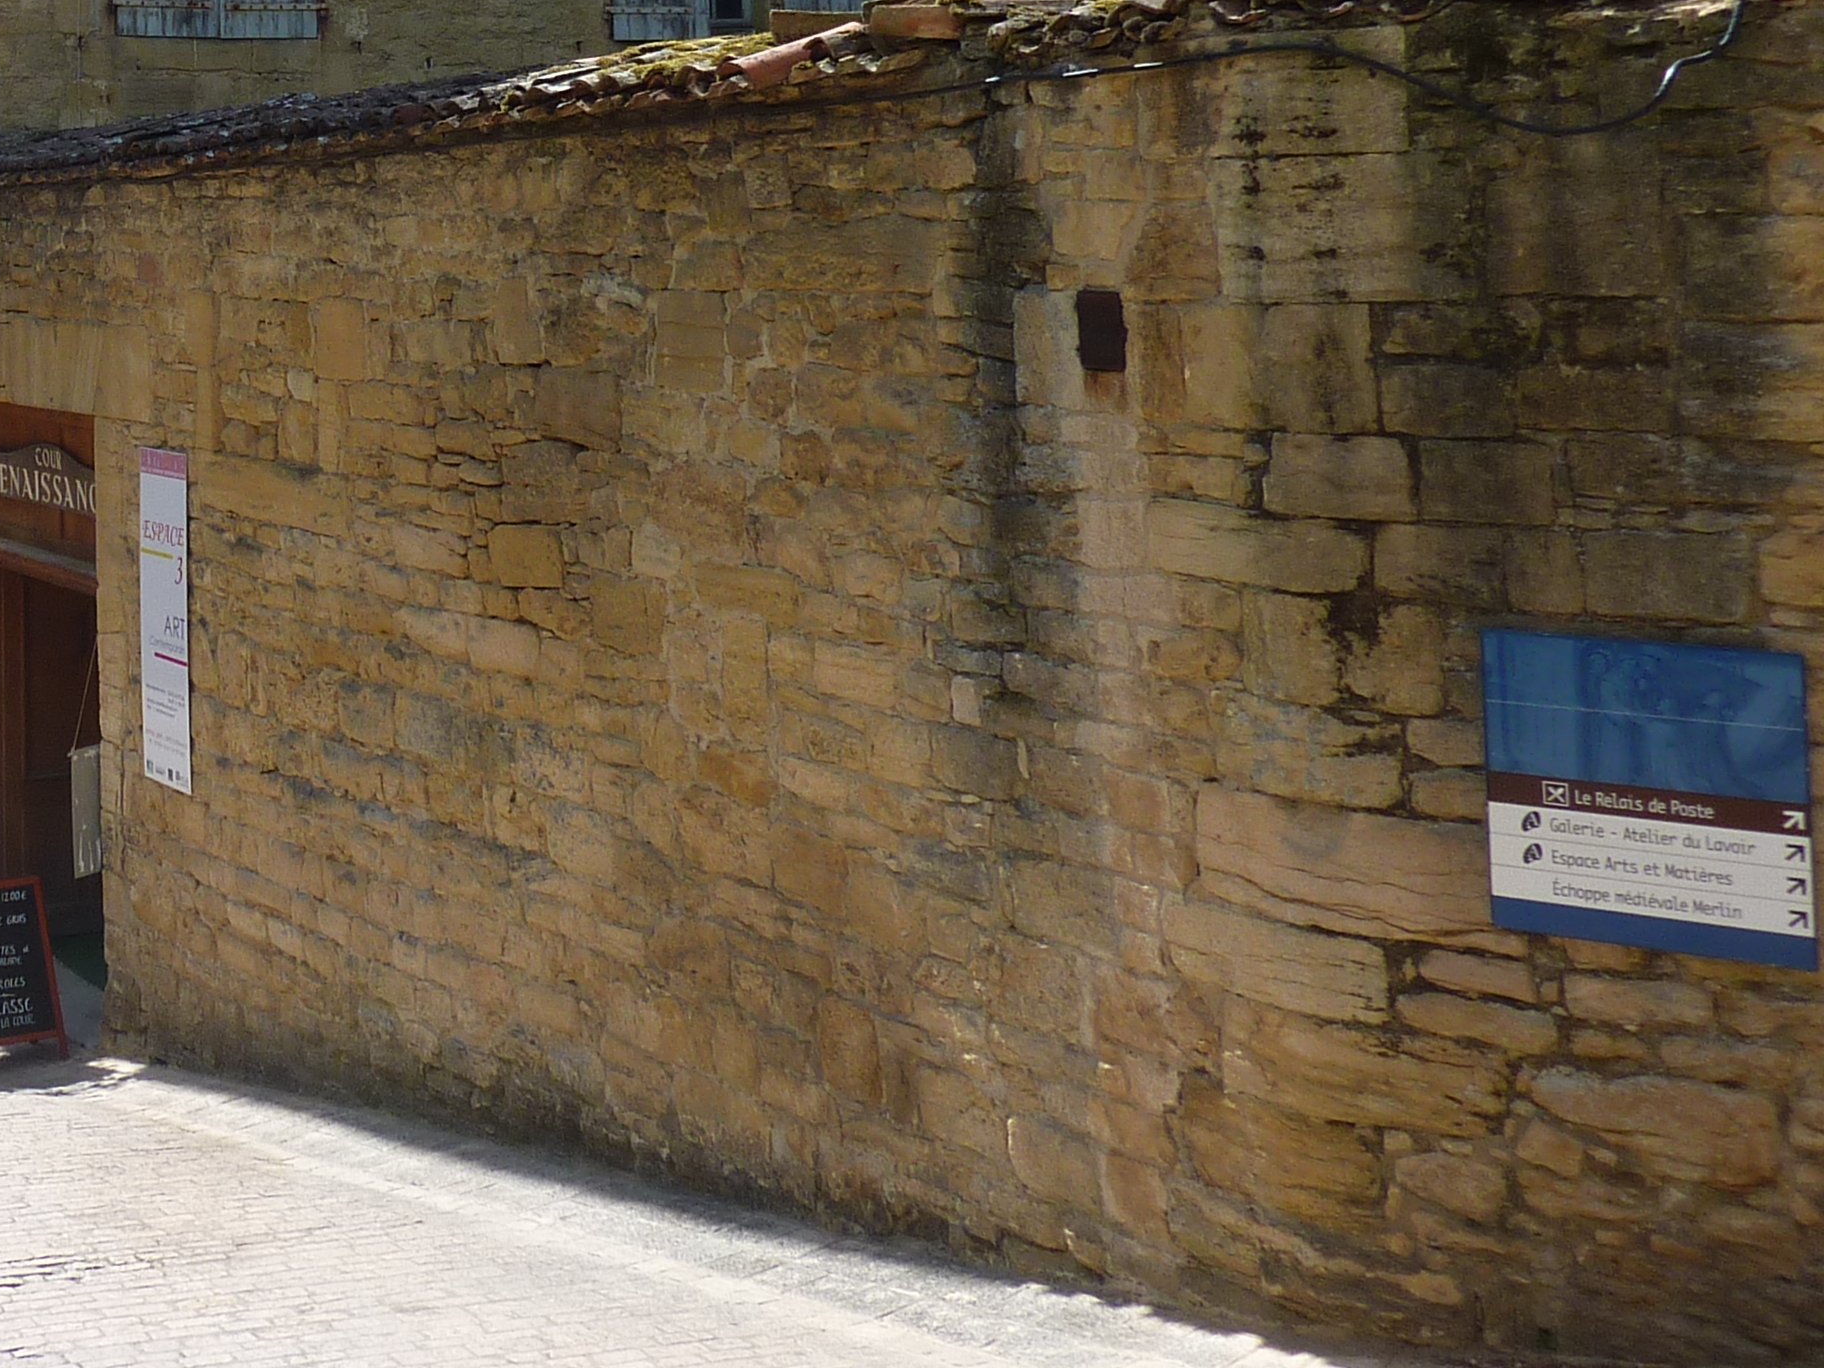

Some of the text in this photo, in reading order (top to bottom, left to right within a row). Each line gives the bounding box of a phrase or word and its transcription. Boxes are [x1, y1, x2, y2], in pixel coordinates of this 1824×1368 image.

[35, 447, 63, 471] COUR
[142, 519, 185, 547] ESPACE
[174, 556, 183, 585] 3
[164, 615, 185, 640] ART
[1575, 789, 1716, 820] Le Relais de Poste
[1549, 817, 1605, 838] Galerie
[1623, 827, 1677, 846] Atelier
[1682, 835, 1700, 850] du
[1705, 837, 1757, 855] Lavoir
[1551, 849, 1734, 886] Espace Arts et Matières
[1552, 877, 1742, 919] Échoppe médiévale Merlin
[0, 1016, 11, 1029] LA
[13, 1014, 36, 1027] COUR
